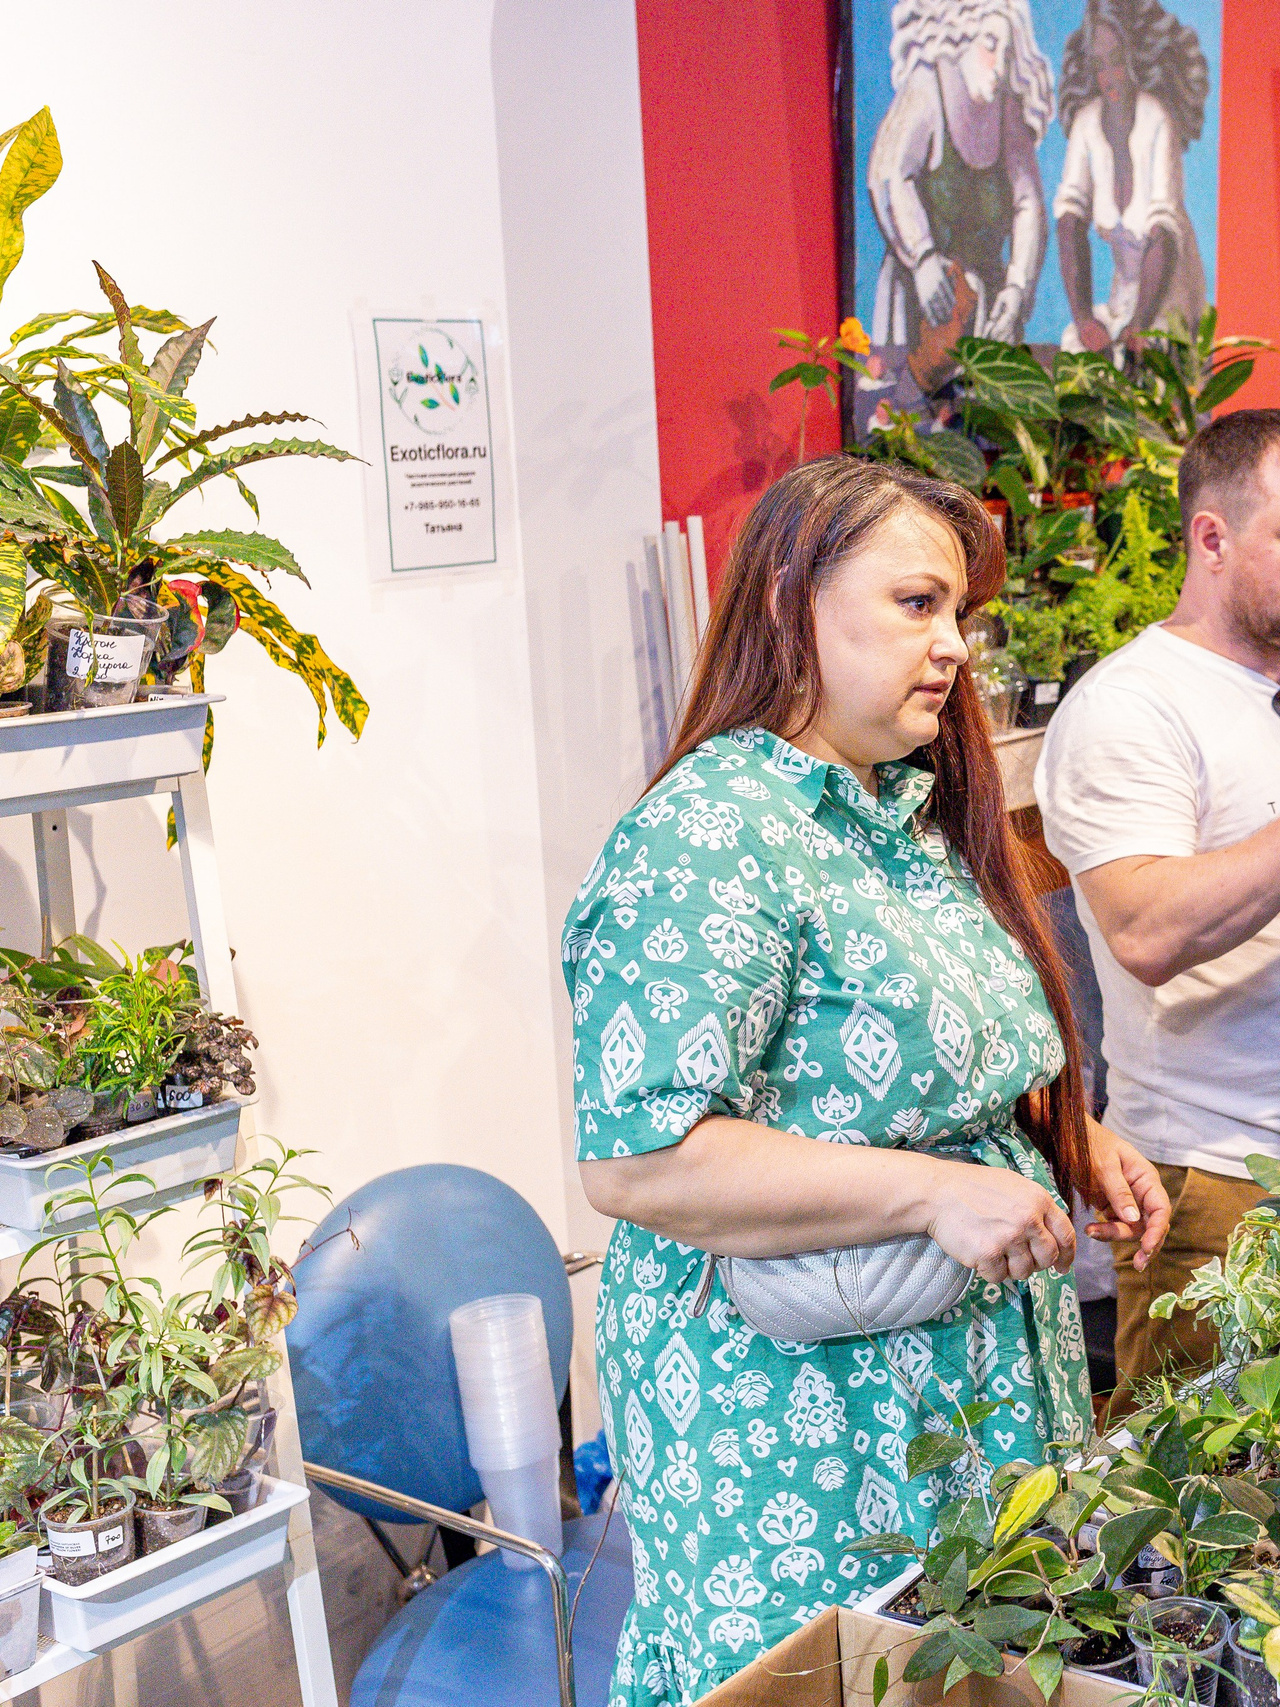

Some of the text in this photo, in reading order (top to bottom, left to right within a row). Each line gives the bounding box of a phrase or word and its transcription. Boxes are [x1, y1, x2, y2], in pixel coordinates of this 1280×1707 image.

[390, 443, 487, 462] Exoticflora.ru
[424, 522, 463, 534] Татьяна
[97, 662, 132, 676] ирога
